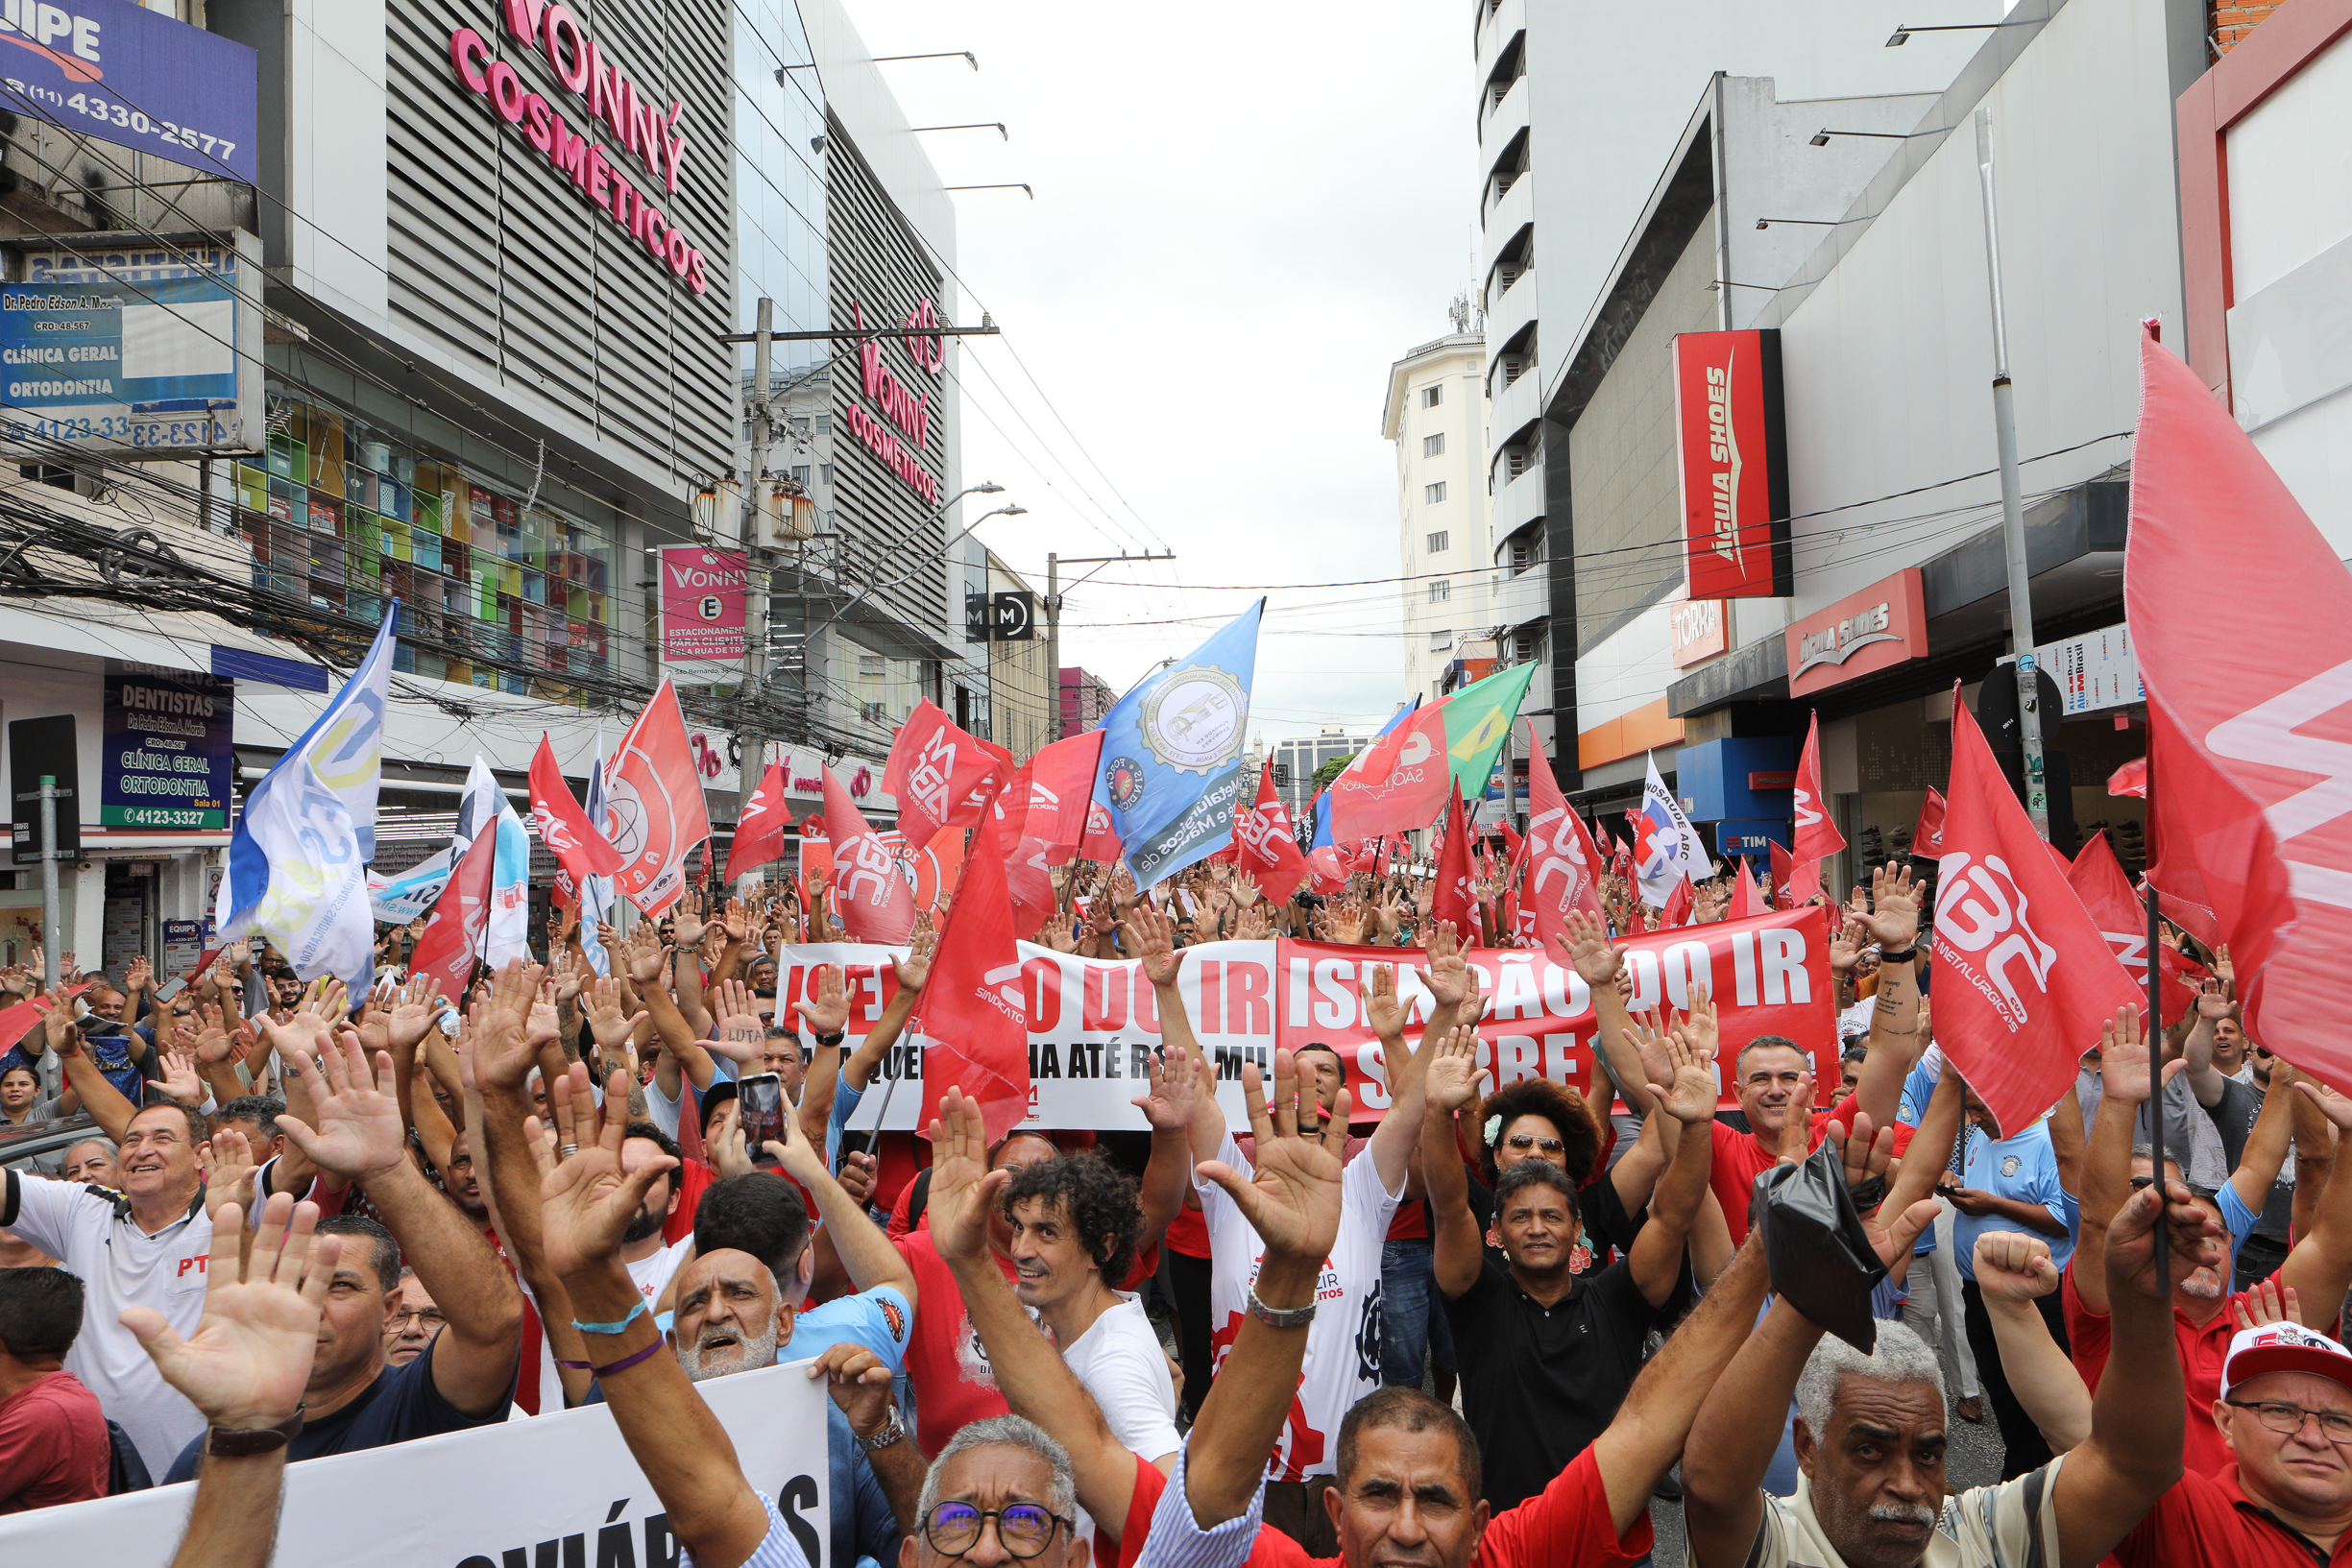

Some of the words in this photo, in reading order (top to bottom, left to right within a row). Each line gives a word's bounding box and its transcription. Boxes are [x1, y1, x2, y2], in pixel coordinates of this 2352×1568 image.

[29, 84, 63, 108] (11)
[67, 92, 236, 160] 4330-2577
[450, 27, 707, 295] COSMÉTICOS
[4, 295, 17, 310] Dr.
[19, 295, 46, 311] Pedro
[48, 295, 78, 311] Edson
[35, 322, 58, 331] CRO:
[60, 321, 90, 331] 48.567
[3, 345, 64, 364] CLÍNICA
[68, 346, 118, 362] GERAL
[10, 379, 112, 398] ORTODONTIA
[1706, 366, 1730, 464] SHOES
[848, 403, 938, 506] COSMÉTICOS
[1710, 471, 1734, 563] ÁGUIA
[704, 598, 716, 617] E
[1675, 596, 1716, 651] TORRA
[669, 637, 700, 647] PARA
[122, 685, 214, 718] DENTISTAS
[138, 714, 158, 733] Pedro
[158, 716, 177, 734] Edson
[184, 719, 206, 737] Morais
[145, 737, 163, 748] CRO:
[163, 739, 186, 750] 48.567
[121, 748, 171, 772] CLÍNICA
[172, 756, 210, 774] GERAL
[121, 775, 210, 797] ORTODONTIA
[194, 799, 210, 808] Sala
[211, 799, 221, 808] 01
[135, 808, 205, 825] 4123-3327
[1680, 832, 1689, 861] ABC
[1741, 835, 1767, 848] TIM
[169, 925, 196, 933] EQUIPE
[1625, 940, 1713, 1013] DO
[1731, 928, 1811, 1006] IR
[974, 986, 1025, 1025] SINDICATO
[1082, 963, 1166, 1034] DO
[1200, 960, 1271, 1035] IR
[728, 1028, 764, 1044] LUTA
[1067, 1037, 1122, 1079] ATÉ
[1214, 1046, 1273, 1081] MIL
[1317, 1288, 1344, 1302] ITOS
